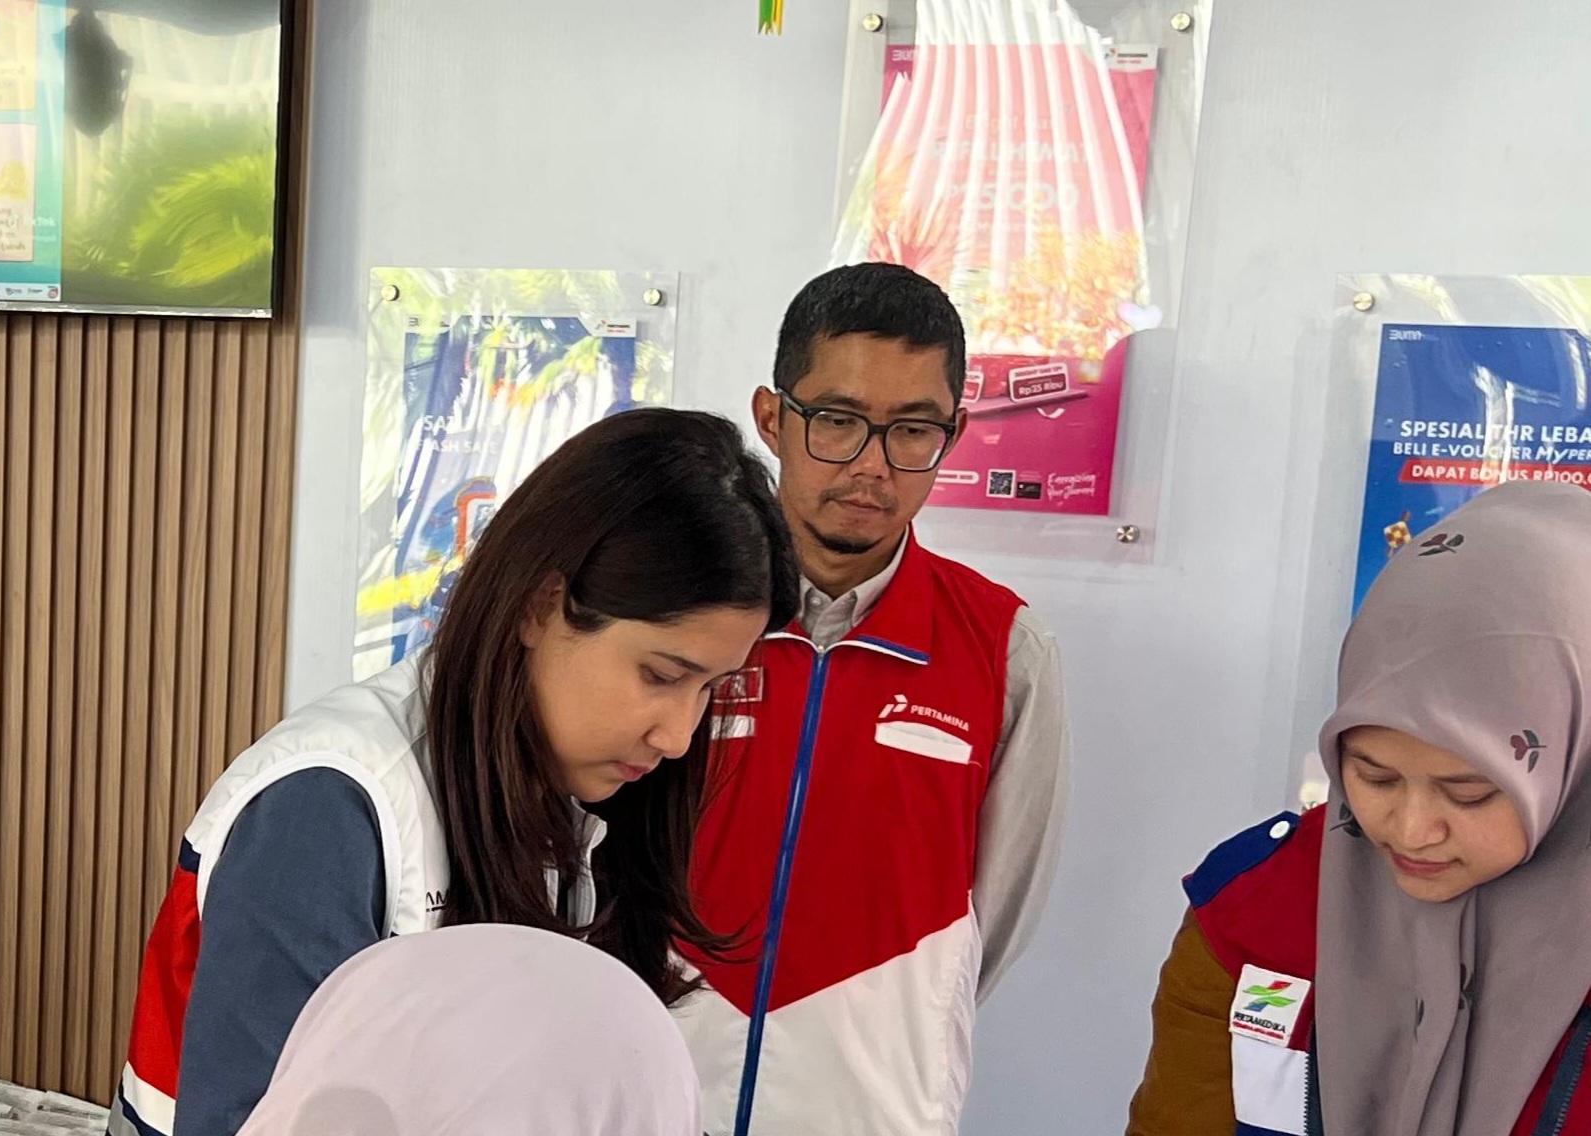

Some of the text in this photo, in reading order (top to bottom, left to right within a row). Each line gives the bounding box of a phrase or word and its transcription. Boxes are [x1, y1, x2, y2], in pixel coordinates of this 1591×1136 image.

[1400, 421, 1485, 439] SPESIAL
[1541, 426, 1591, 443] LEBA
[1393, 442, 1426, 455] BELI
[1411, 465, 1466, 479] DAPAT
[1470, 466, 1527, 481] BONUS
[910, 704, 969, 732] PERTAMINA
